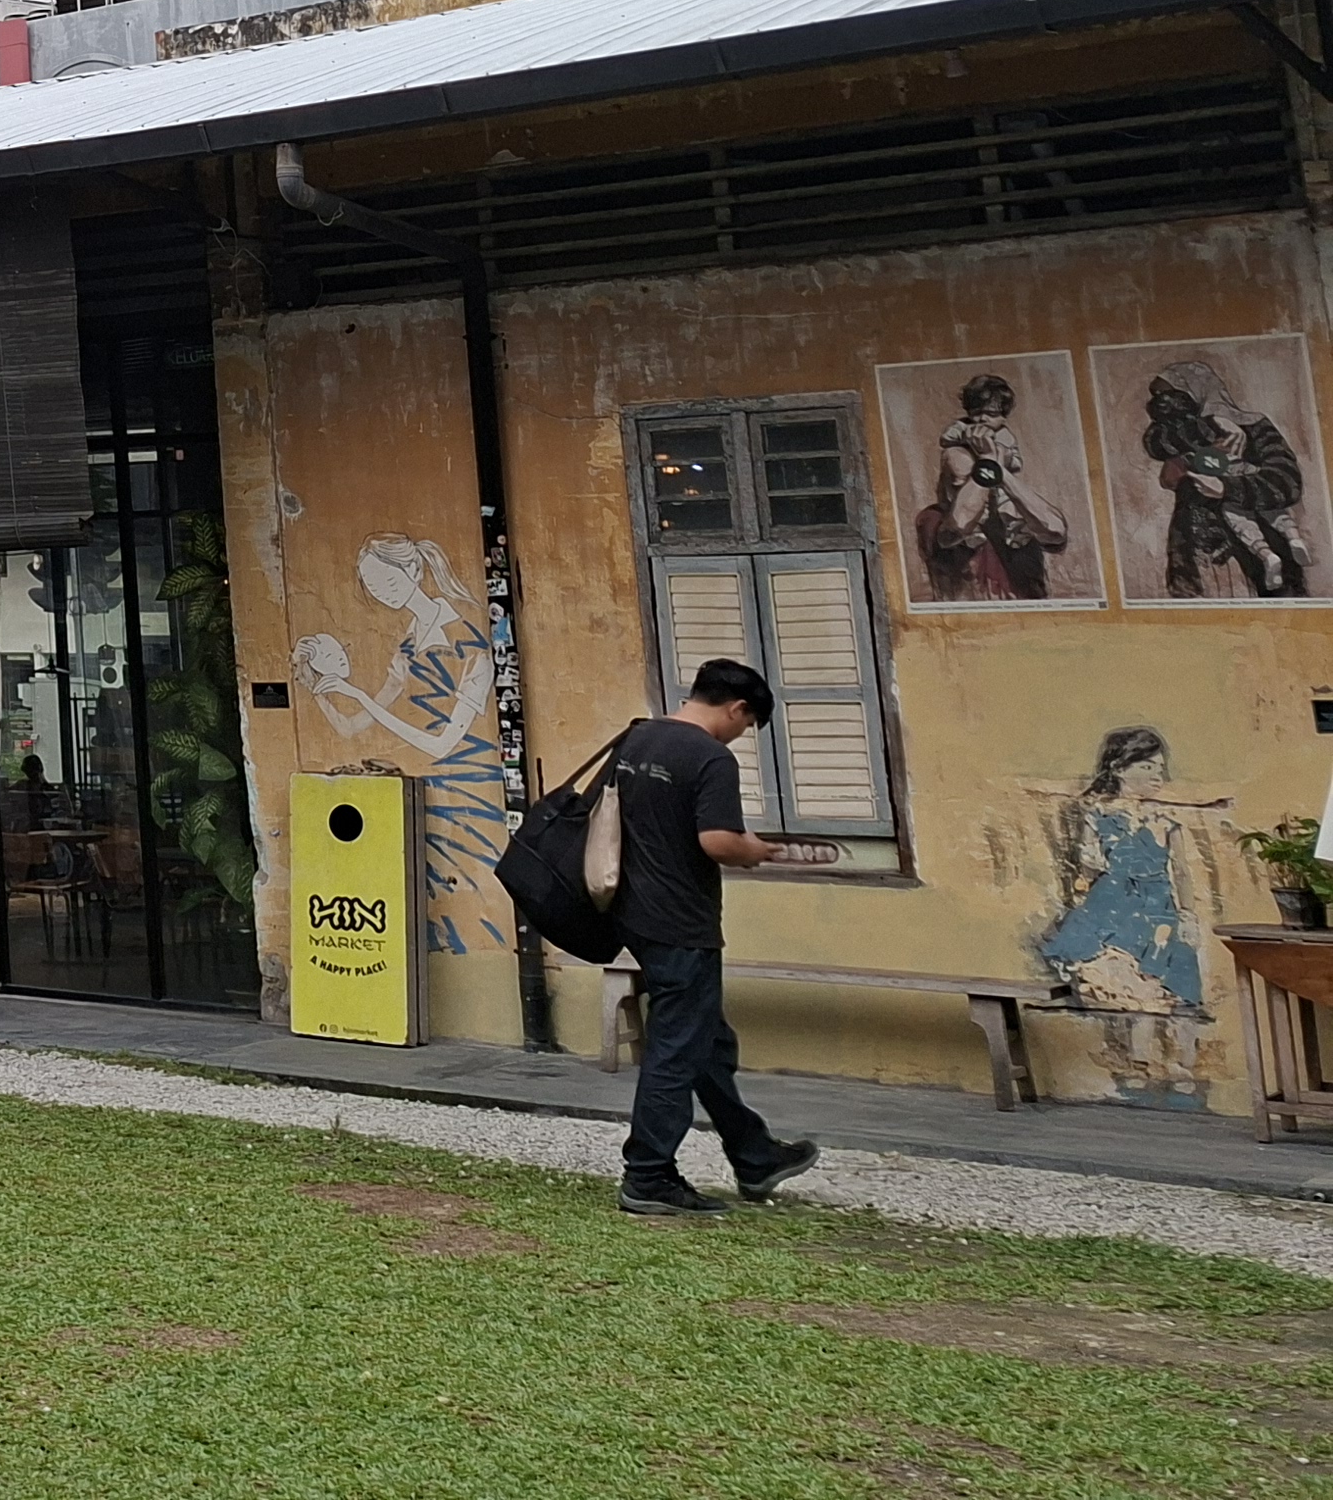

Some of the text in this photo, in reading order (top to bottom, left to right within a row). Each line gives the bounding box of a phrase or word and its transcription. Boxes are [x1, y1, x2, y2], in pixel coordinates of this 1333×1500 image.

[309, 894, 386, 933] HIN
[308, 934, 386, 952] MARKET
[309, 955, 388, 977] A HAPPY PLACE!
